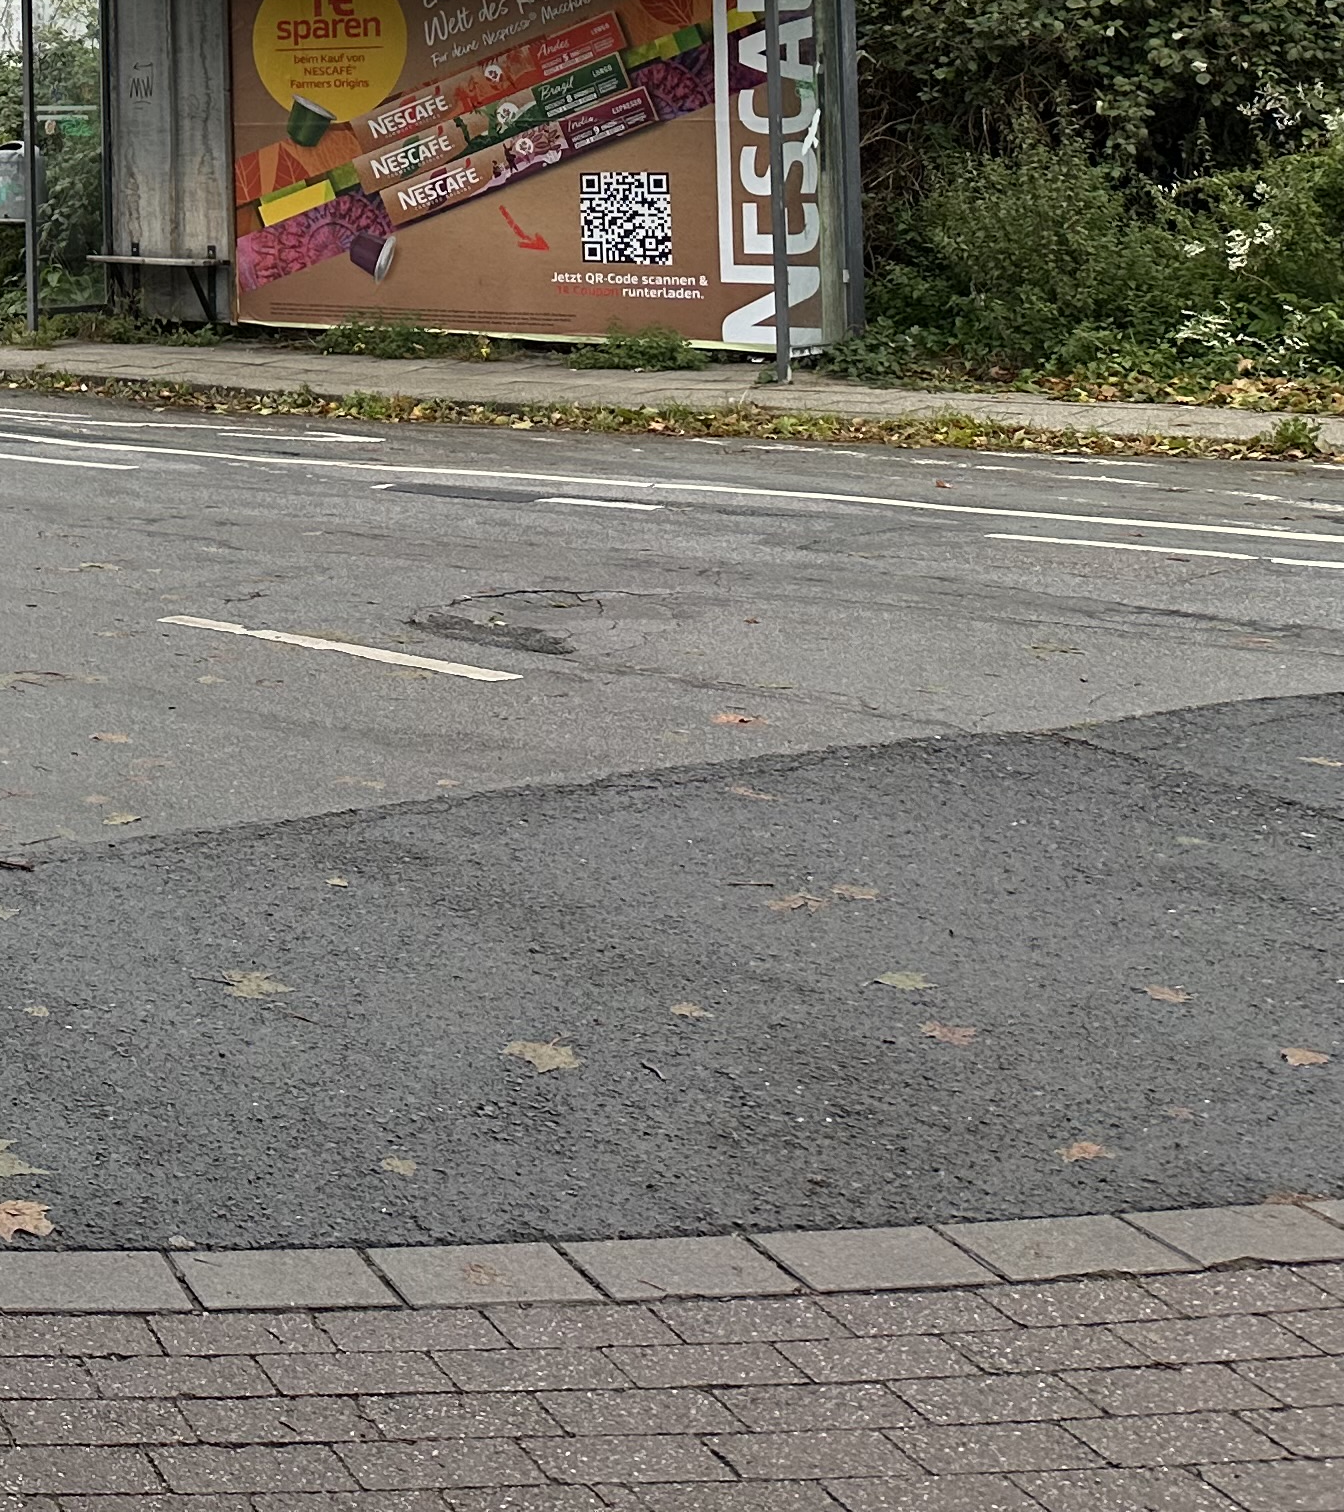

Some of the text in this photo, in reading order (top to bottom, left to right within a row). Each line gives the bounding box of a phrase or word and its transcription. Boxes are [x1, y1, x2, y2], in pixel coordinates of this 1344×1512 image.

[276, 16, 382, 46] sparen
[423, 6, 474, 47] Welt
[537, 38, 570, 60] Andes
[293, 53, 366, 65] beim Kauf von
[289, 78, 370, 90] Farmers Origins
[550, 271, 709, 287] Jetzt QR-Code scannen &
[622, 287, 705, 300] runterladen.
